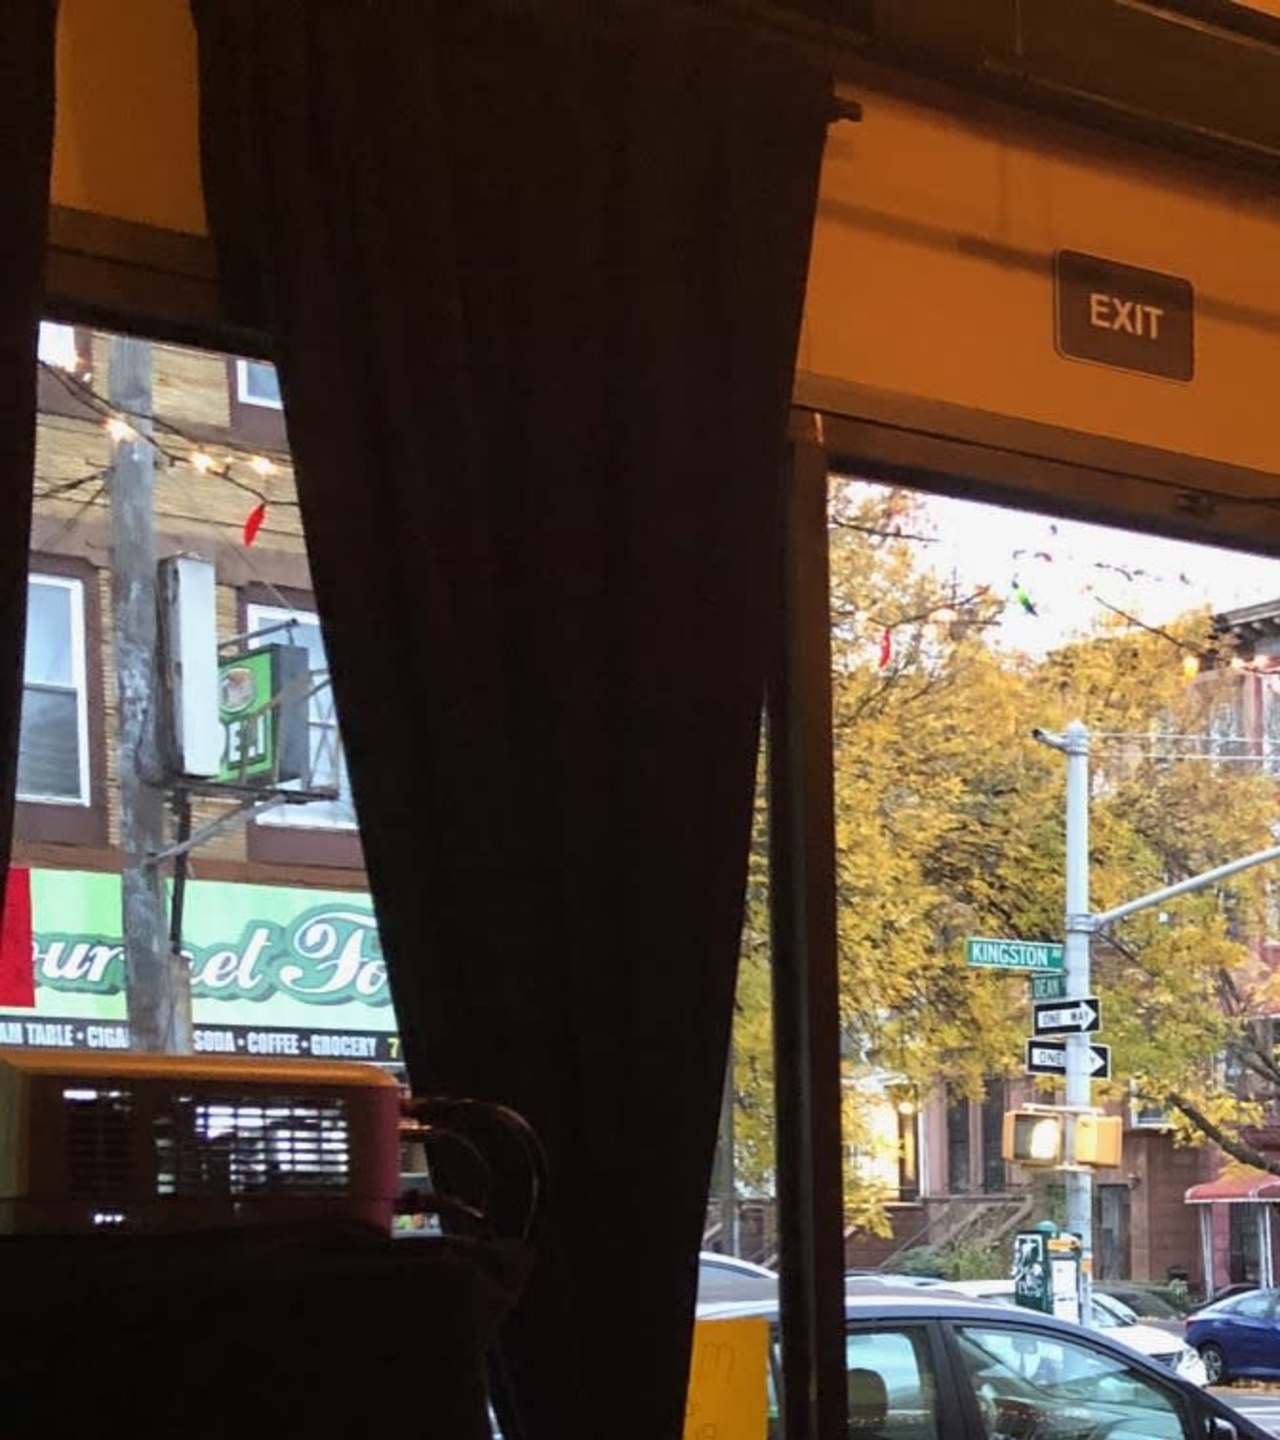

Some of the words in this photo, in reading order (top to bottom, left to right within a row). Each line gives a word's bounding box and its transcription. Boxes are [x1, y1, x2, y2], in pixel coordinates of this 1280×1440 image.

[1090, 293, 1164, 340] EXIT
[33, 928, 271, 989] uret
[972, 942, 1049, 967] KINGSTON
[1034, 979, 1061, 998] DEAN
[1042, 1012, 1061, 1024] ONE
[1070, 1010, 1090, 1022] WAY
[25, 1023, 75, 1046] TABLE
[193, 1030, 236, 1052] SODA
[246, 1032, 300, 1055] COFFEE
[310, 1034, 377, 1057] GROCERY
[1038, 1050, 1064, 1069] ONE
